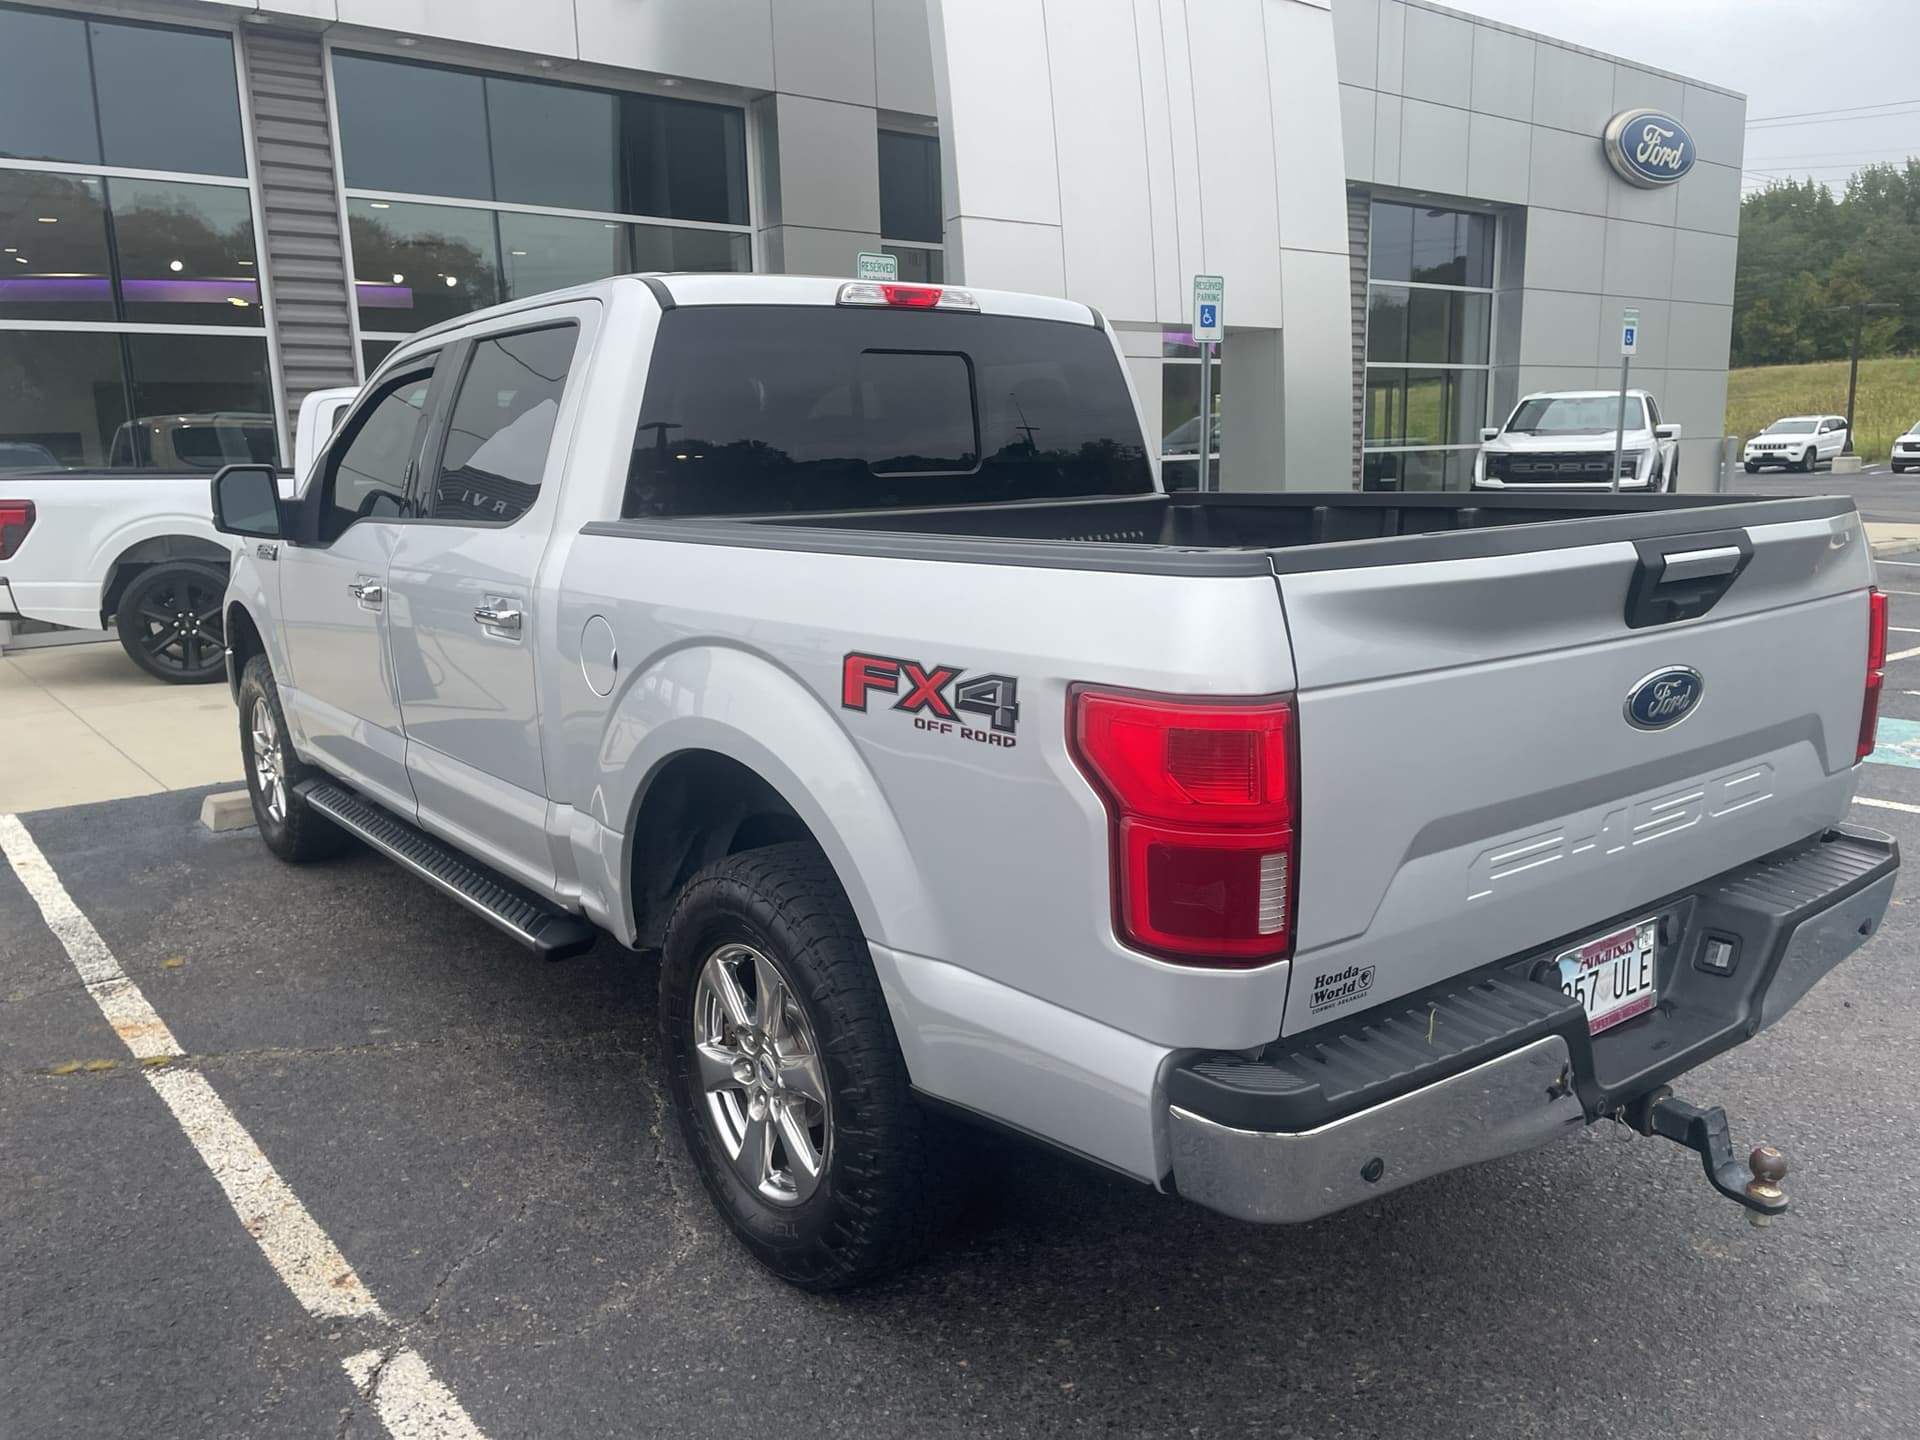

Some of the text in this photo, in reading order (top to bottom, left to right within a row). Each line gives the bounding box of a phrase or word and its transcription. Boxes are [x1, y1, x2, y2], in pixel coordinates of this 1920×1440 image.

[1637, 124, 1684, 169] Ford
[861, 261, 896, 273] RESERVED
[1196, 281, 1222, 291] RESERVED
[1197, 292, 1220, 302] PARKING
[1510, 462, 1608, 473] FORD
[841, 650, 1019, 734] FX4
[1648, 679, 1692, 718] Ford
[914, 716, 1017, 748] OFF ROAD
[1313, 965, 1360, 989] Honda
[1613, 948, 1652, 1000] ULE
[1314, 980, 1356, 1004] World
